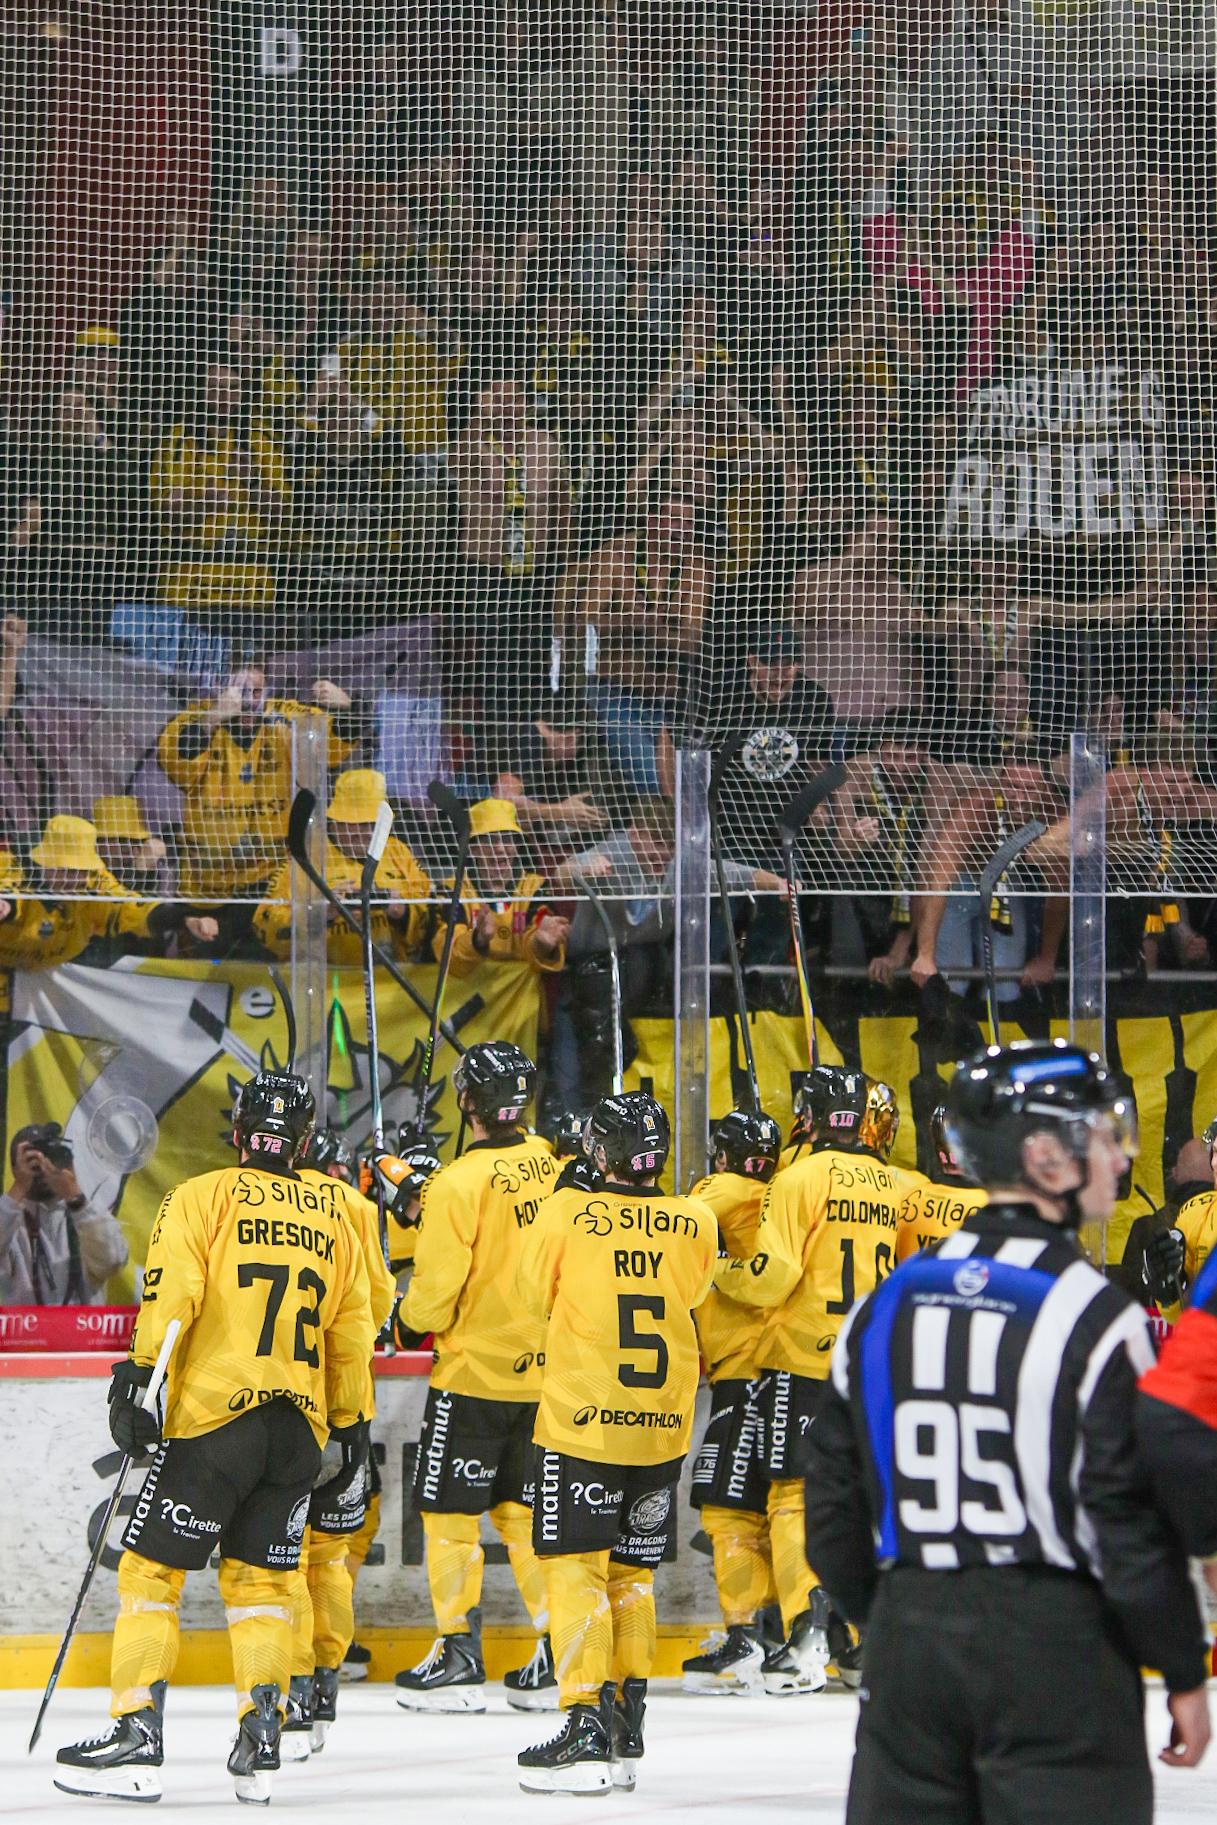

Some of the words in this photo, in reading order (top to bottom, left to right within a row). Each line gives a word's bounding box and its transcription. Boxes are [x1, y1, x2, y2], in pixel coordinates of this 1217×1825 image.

[260, 28, 304, 75] D
[939, 440, 1167, 543] ROUEN
[240, 986, 276, 1017] e
[263, 1136, 283, 1154] 72
[757, 1158, 766, 1173] 7
[620, 1205, 698, 1239] silam
[826, 1199, 899, 1232] COLOMBA
[237, 1218, 336, 1264] GRESOCK
[614, 1250, 663, 1279] ROY
[237, 1262, 328, 1369] 72
[617, 1294, 669, 1389] 5
[600, 1409, 682, 1429] DECATHLON
[769, 1370, 791, 1469] matmut
[423, 1398, 453, 1500] matmut
[894, 1400, 1028, 1535] 95
[160, 1498, 222, 1533] ?Cirette
[321, 1513, 340, 1521] LES
[269, 1544, 287, 1555] LES
[628, 1535, 667, 1546] DRAGONS
[267, 1555, 286, 1564] VOUS
